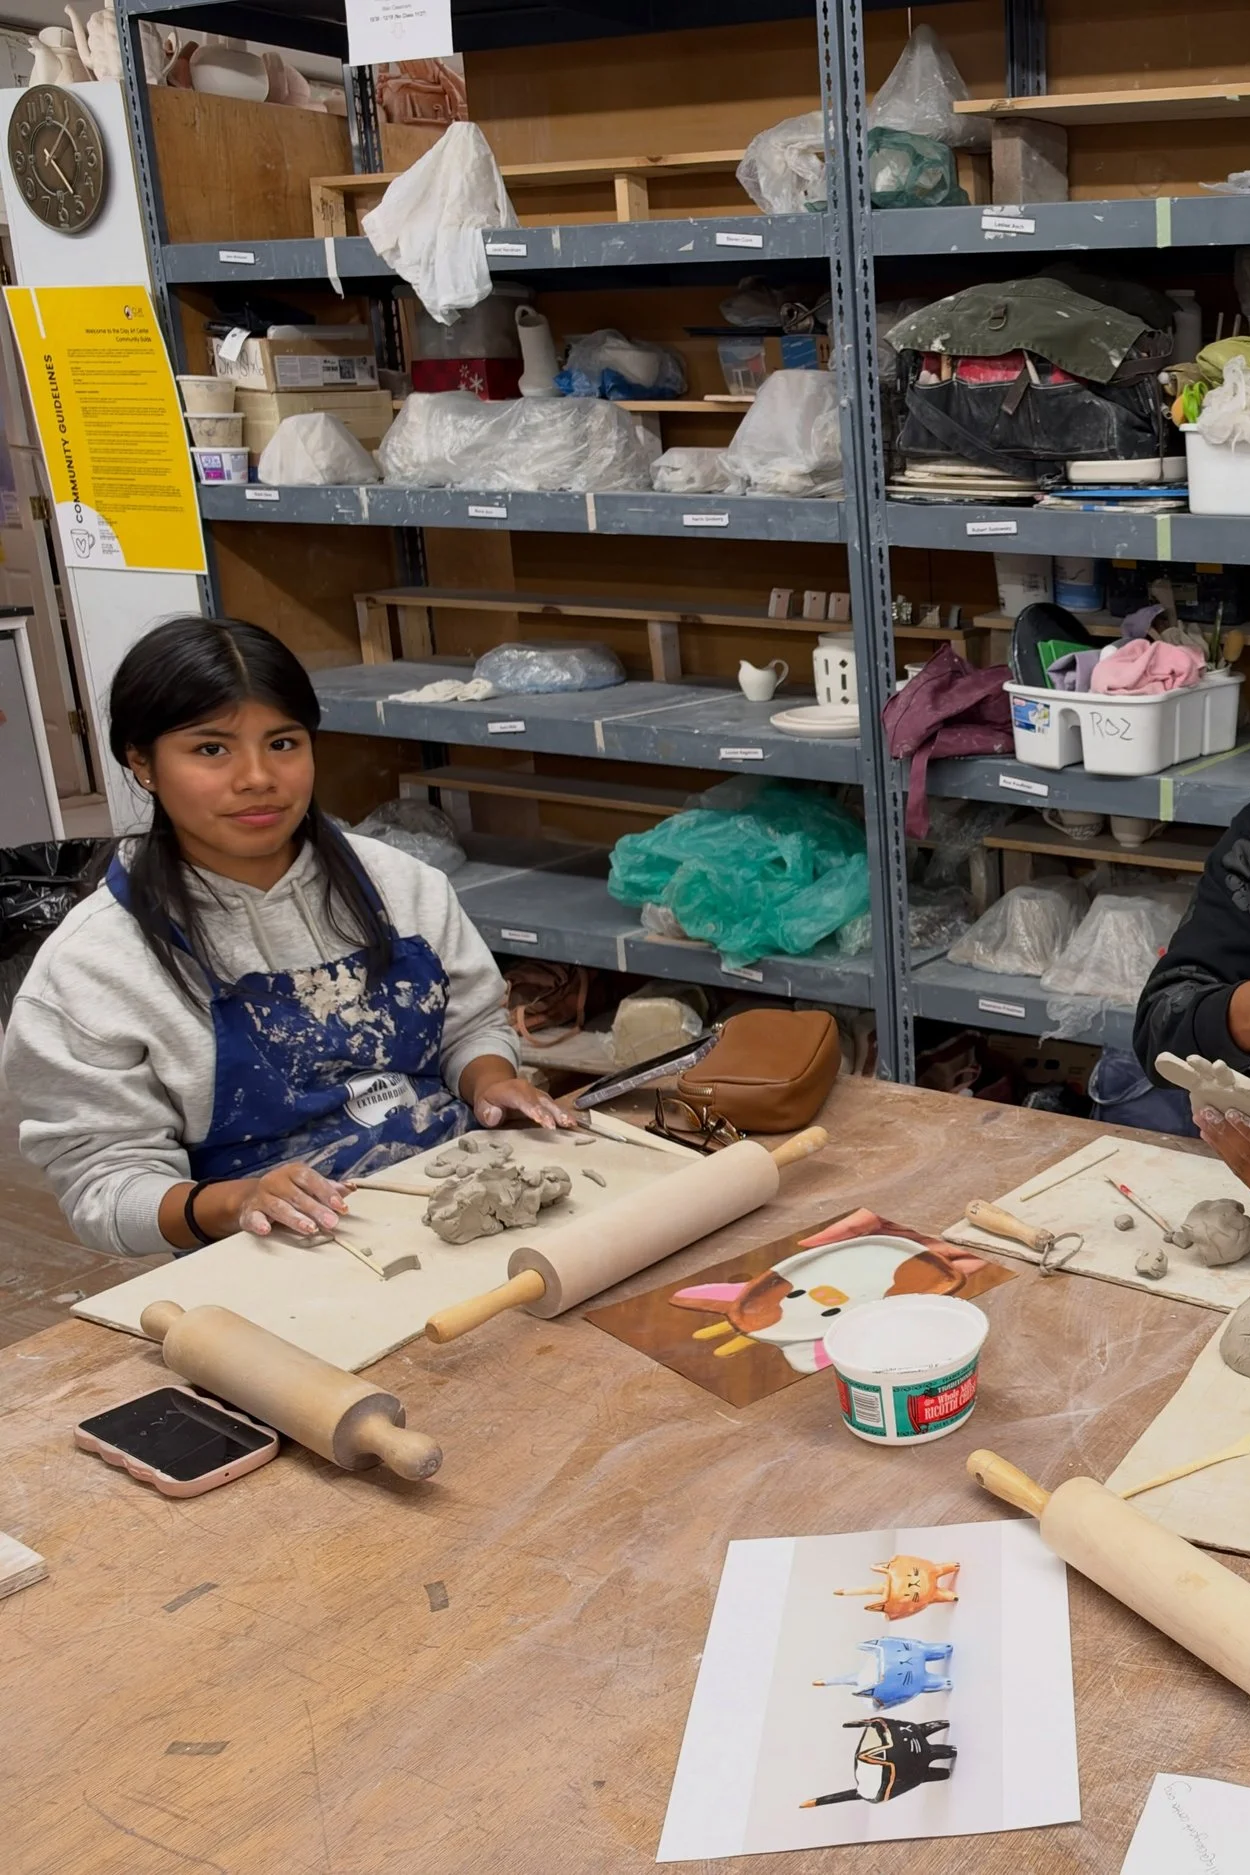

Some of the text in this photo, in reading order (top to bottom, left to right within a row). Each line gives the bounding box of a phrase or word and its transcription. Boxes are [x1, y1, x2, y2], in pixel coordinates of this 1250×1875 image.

[44, 354, 84, 524] COMMUNITY GUIDELINES
[924, 1396, 958, 1420] RICOTTA
